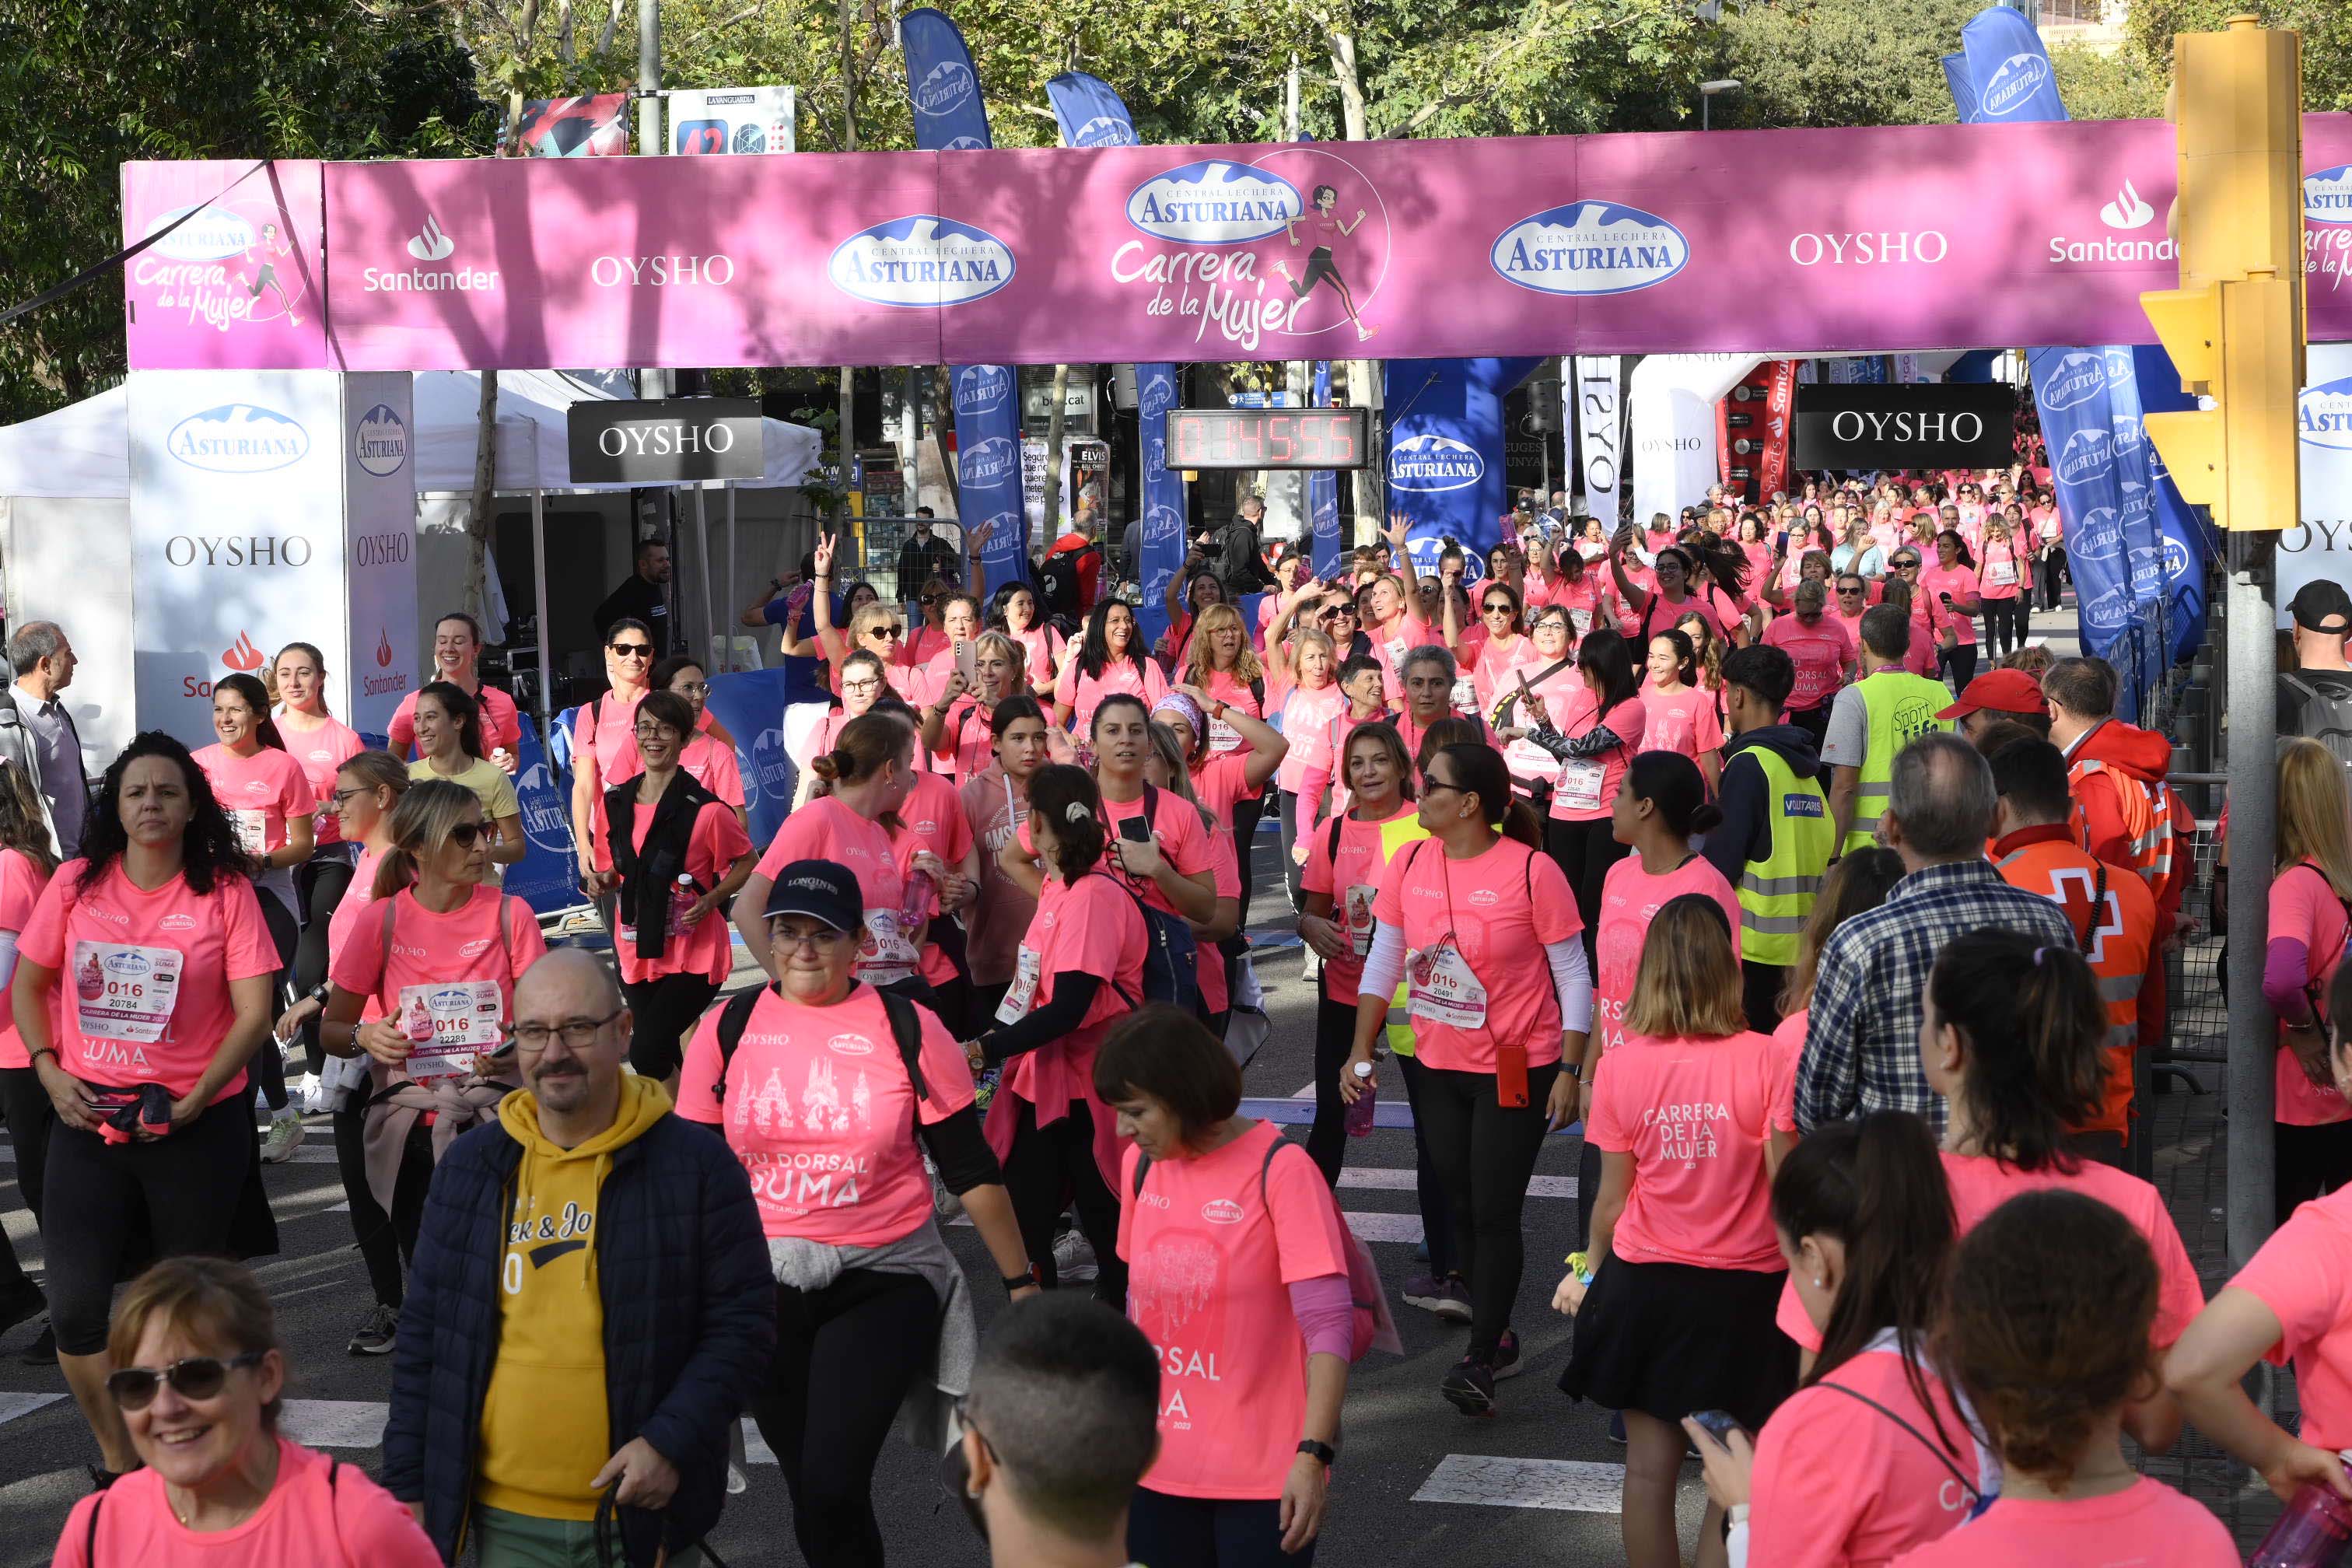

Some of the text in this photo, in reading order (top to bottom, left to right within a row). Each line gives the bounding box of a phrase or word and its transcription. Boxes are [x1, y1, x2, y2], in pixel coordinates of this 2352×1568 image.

[1167, 187, 1283, 198] CENTRAL LECHERA
[1139, 192, 1289, 223] ASTURIANA
[1537, 232, 1668, 244] CENTRAL LECHERA
[1790, 230, 1948, 265] OYSHO
[2049, 236, 2179, 262] Santand
[871, 246, 995, 256] CENTRAL LECHERA
[1111, 240, 1258, 283] Carrera
[1506, 236, 1674, 272] ASTURIANA
[135, 257, 226, 289] Carrera
[591, 254, 734, 286] OYSHO
[845, 250, 1001, 283] ASTURIANA
[365, 266, 499, 292] Santander
[157, 282, 261, 331] de la Mujer
[1147, 278, 1311, 351] de la Mujer
[1832, 411, 1983, 443] OYSHO
[179, 429, 299, 456] ASTURIANA
[359, 432, 404, 459] ASTURIANA
[599, 423, 733, 457] OYSHO
[1642, 437, 1701, 453] OYSHO
[1082, 450, 1106, 461] ELVIS
[1764, 440, 1783, 493] Sports
[1024, 464, 1037, 472] que
[1389, 457, 1477, 479] ASTURIANA
[1024, 495, 1039, 503] este
[165, 535, 312, 567] OYSHO
[357, 532, 409, 567] OYSHO
[364, 672, 408, 696] Santander
[1895, 702, 1931, 731] Sport
[108, 959, 148, 971] ASTURIANA
[107, 981, 143, 997] 016
[1432, 972, 1458, 989] 016
[109, 998, 138, 1010] 20784
[432, 998, 471, 1009] ASTURIANA
[1433, 988, 1454, 998] 20491
[436, 1017, 469, 1033] 016
[439, 1034, 467, 1045] 22289
[460, 1045, 481, 1053] MUJER
[740, 1033, 789, 1045] OYSHO
[415, 1060, 445, 1070] OYSHO
[1643, 1102, 1729, 1126] CARRERA
[1659, 1122, 1715, 1143] DE LA
[1659, 1140, 1717, 1161] MUJER
[777, 1153, 868, 1174] DORSAL
[538, 1214, 556, 1239] &
